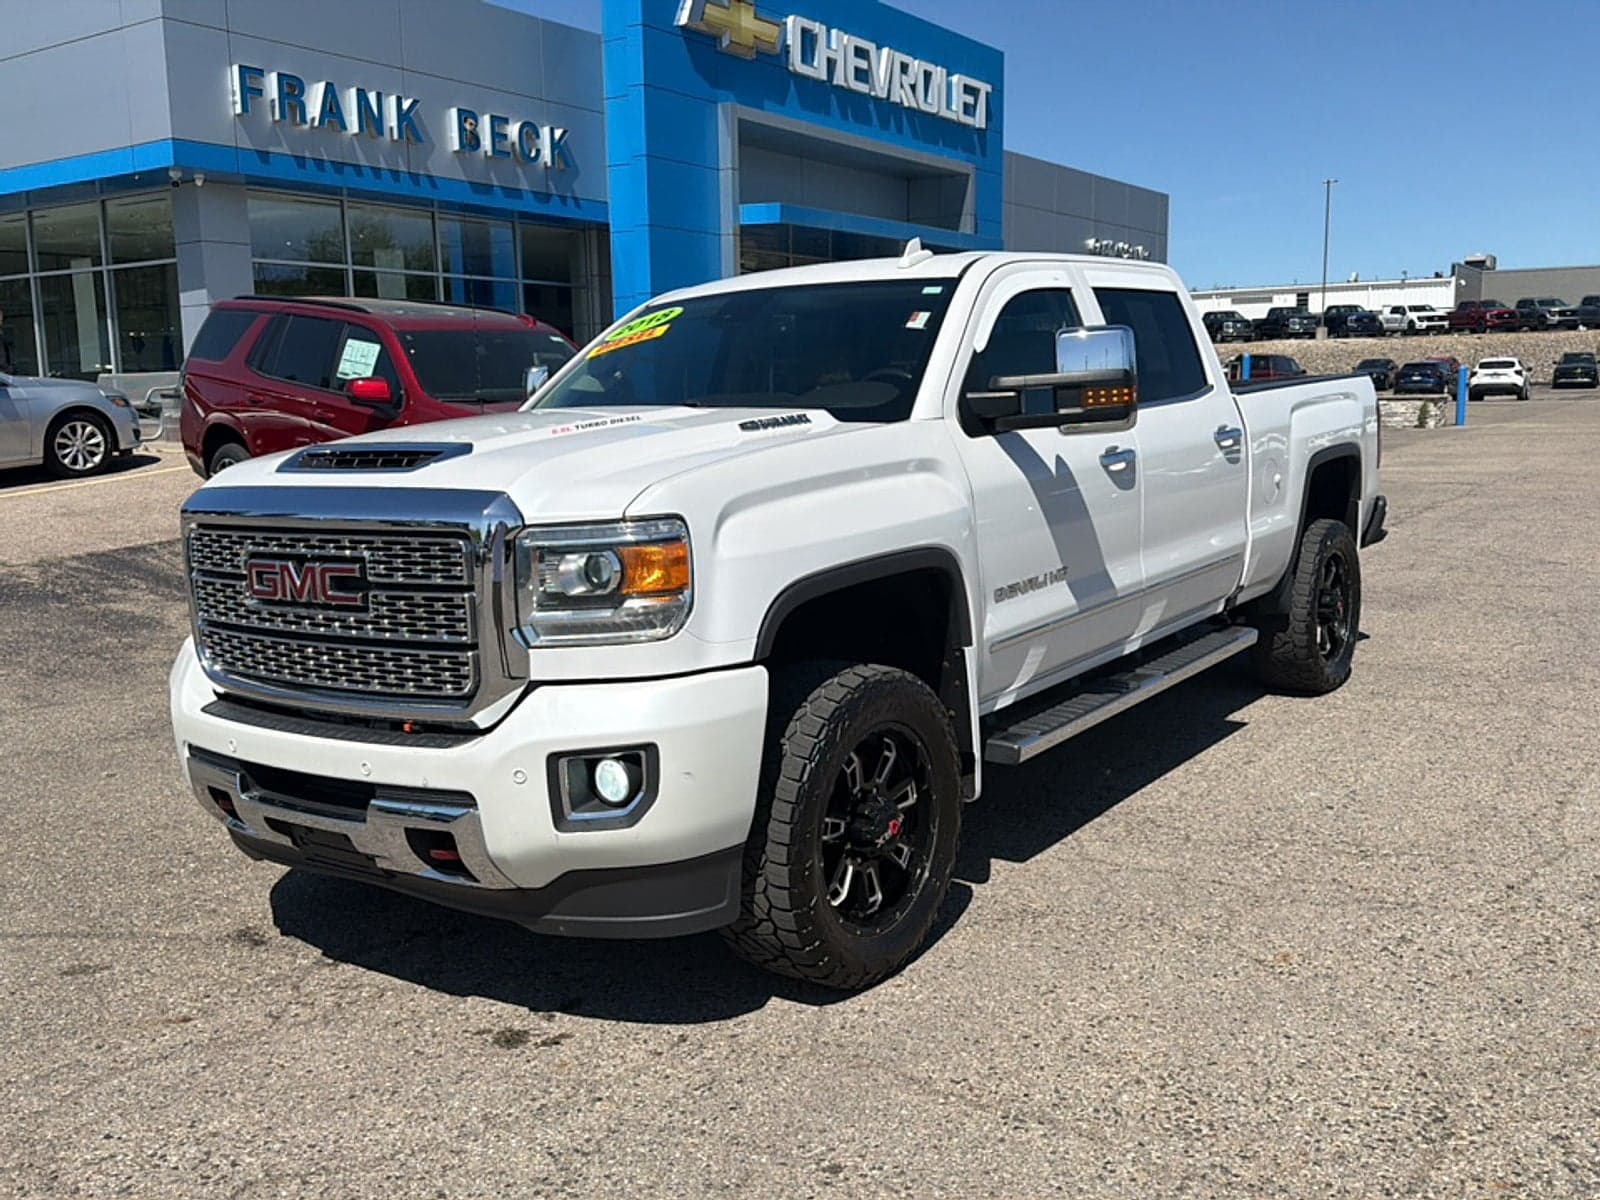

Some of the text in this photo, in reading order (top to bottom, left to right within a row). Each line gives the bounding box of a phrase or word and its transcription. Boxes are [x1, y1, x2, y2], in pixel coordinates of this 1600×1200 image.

[786, 14, 992, 129] CHEVROLET
[231, 63, 572, 169] FRANK BECK
[575, 420, 608, 430] TURBO
[610, 415, 641, 425] DIESEL
[247, 559, 361, 606] GMC
[993, 572, 1047, 604] DENALI
